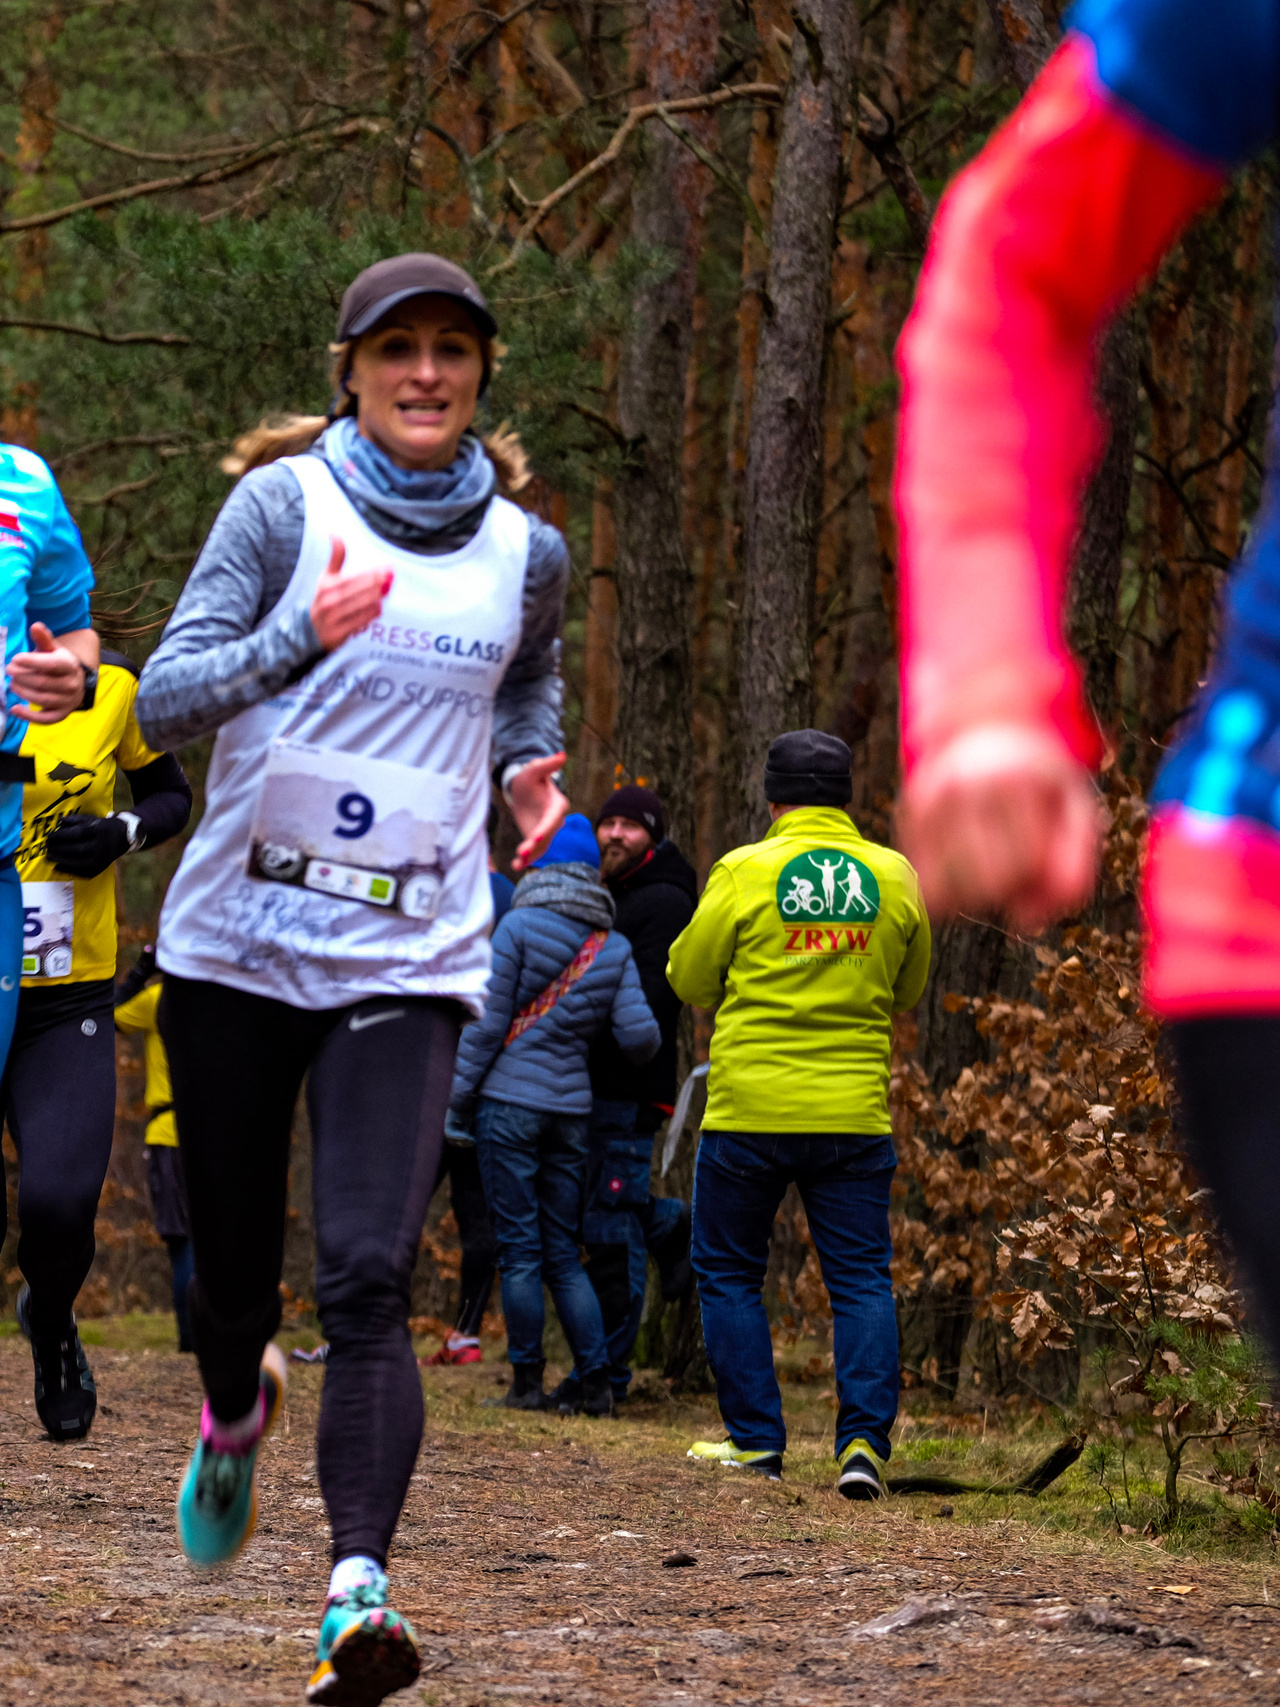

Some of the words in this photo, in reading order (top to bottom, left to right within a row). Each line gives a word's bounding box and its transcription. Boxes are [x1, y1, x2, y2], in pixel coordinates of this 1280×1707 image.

[371, 621, 505, 664] RESSGLASS
[399, 680, 493, 719] SUPPO
[333, 792, 375, 839] 9
[23, 906, 43, 938] 5
[783, 928, 873, 952] ZRYW
